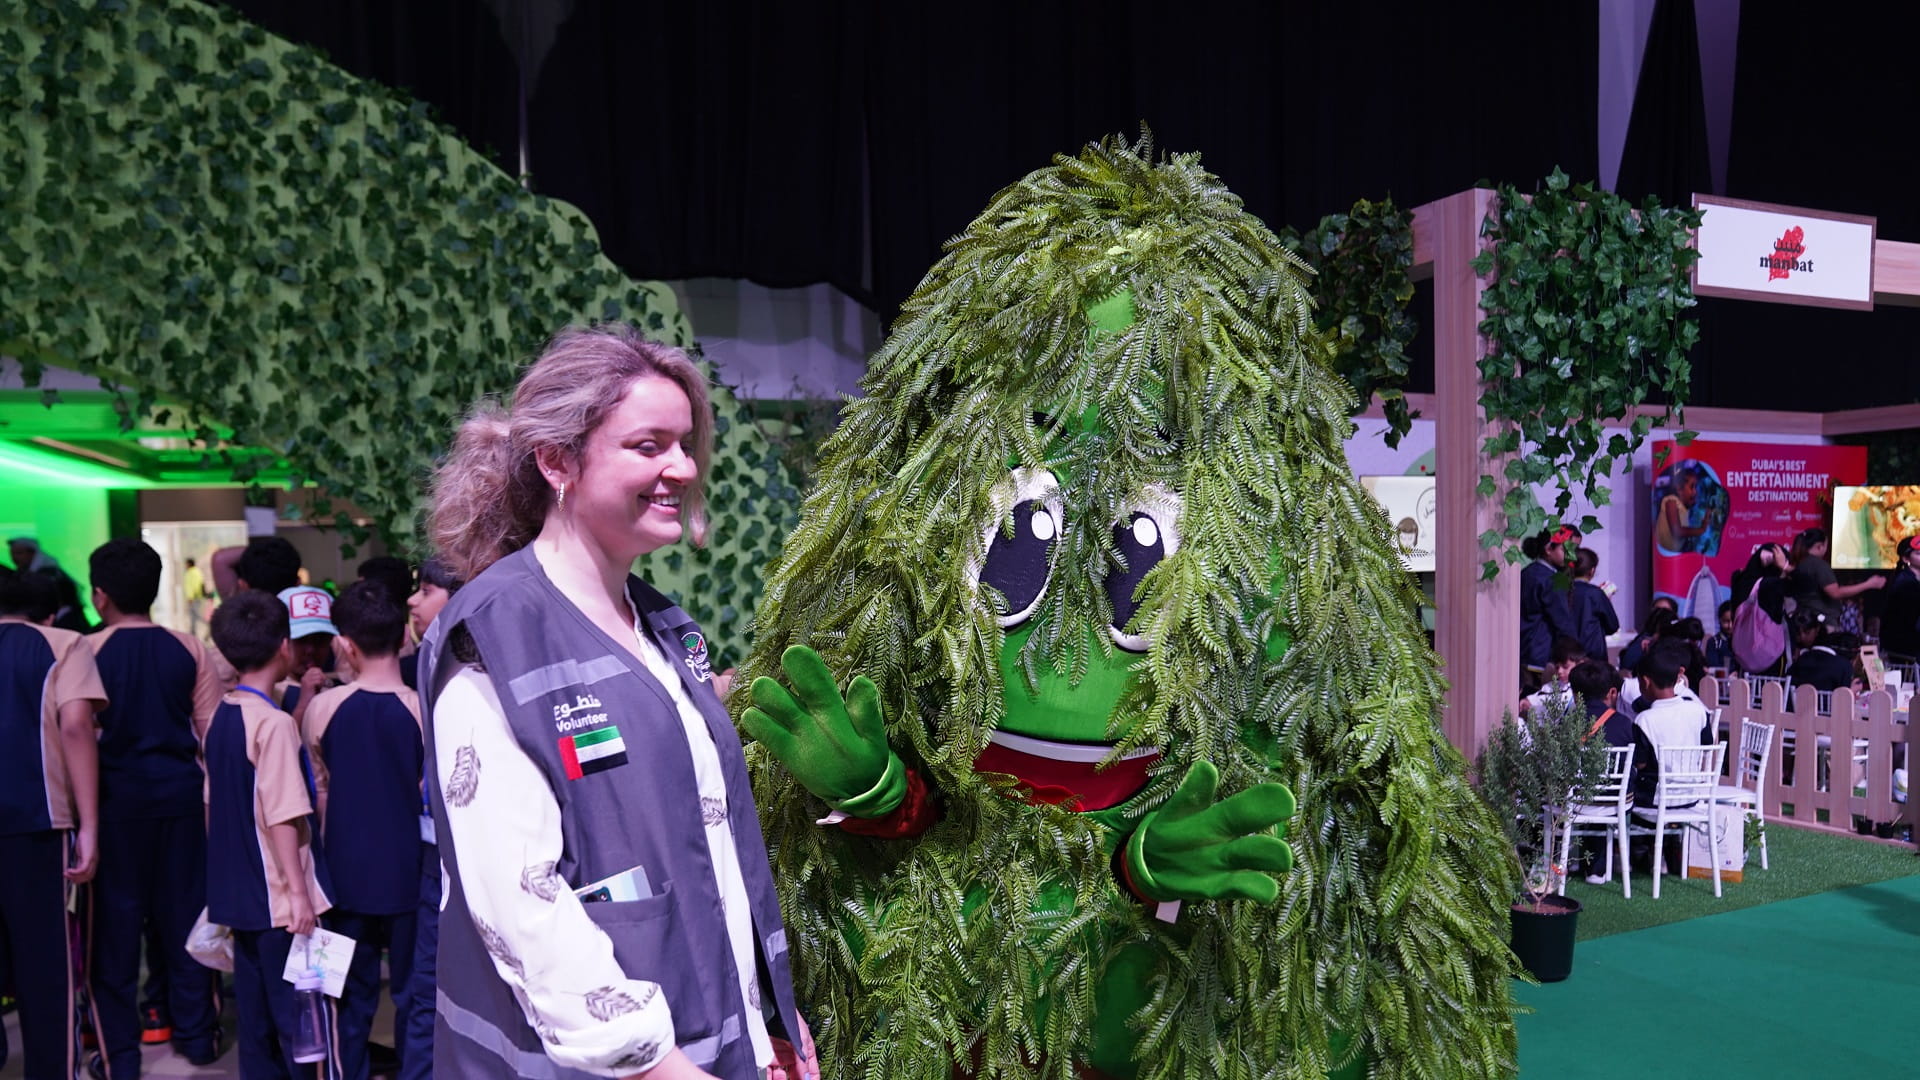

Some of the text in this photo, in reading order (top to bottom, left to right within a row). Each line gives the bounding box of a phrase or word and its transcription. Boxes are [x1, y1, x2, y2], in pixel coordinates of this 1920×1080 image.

[1760, 256, 1814, 273] manbat
[1752, 459, 1806, 471] DUBAI'S BEST
[1727, 471, 1829, 488] ENTERTAINMENT
[1748, 490, 1809, 502] DESTINATIONS
[556, 713, 608, 732] Volunteer
